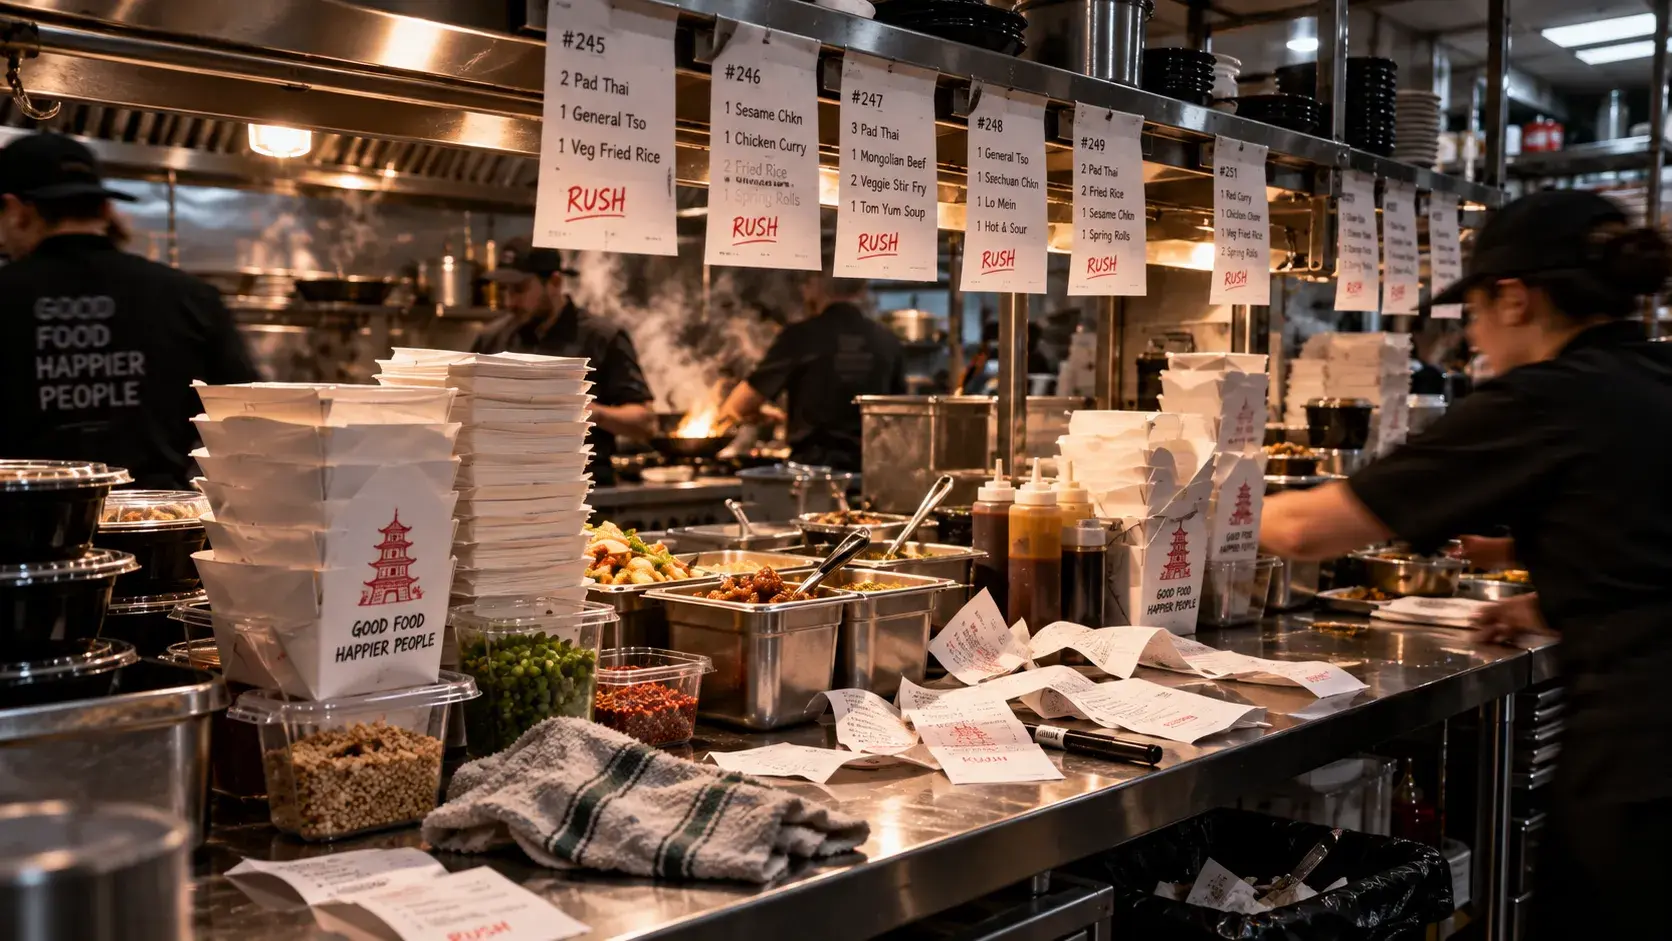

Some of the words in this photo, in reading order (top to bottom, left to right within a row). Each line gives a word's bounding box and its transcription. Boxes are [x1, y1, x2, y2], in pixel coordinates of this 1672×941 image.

[562, 30, 606, 54] #245
[560, 70, 569, 86] 2
[574, 72, 598, 92] Pad
[602, 78, 629, 96] Thai
[725, 64, 761, 85] #246
[852, 89, 883, 108] #247
[560, 104, 566, 119] 1
[572, 106, 621, 127] General
[626, 113, 647, 130] Tso
[725, 101, 730, 114] 1
[735, 103, 775, 121] Sesame
[777, 109, 803, 126] Chkn
[851, 122, 858, 135] 3
[861, 123, 878, 138] Pad
[880, 126, 900, 141] Thai
[977, 116, 1003, 133] #248
[559, 138, 565, 153] 1
[571, 139, 595, 161] Veg
[600, 144, 631, 162] Fried
[636, 147, 661, 164] Rice
[725, 131, 730, 143] 1
[735, 132, 776, 150] Chicken
[779, 138, 807, 157] Curry
[1081, 137, 1105, 151] #249
[852, 149, 856, 160] 1
[861, 151, 904, 169] Mongolian
[907, 156, 926, 170] Beef
[978, 147, 982, 158] 1
[985, 147, 1014, 162] General
[1016, 153, 1029, 165] Tso
[724, 159, 731, 172] 2
[735, 160, 763, 176] Fried
[765, 163, 787, 179] Rice
[1081, 163, 1087, 174] 2
[1089, 165, 1103, 177] Pad
[1104, 166, 1118, 178] Thai
[1220, 166, 1238, 179] #251
[851, 175, 857, 186] 2
[860, 175, 890, 193] Veggie
[893, 179, 909, 192] Stir
[912, 183, 927, 197] Fry
[978, 171, 981, 182] 1
[1021, 177, 1039, 190] Chkn
[567, 186, 626, 213] RUSH
[776, 191, 801, 207] Rolls
[1081, 186, 1087, 196] 2
[1089, 186, 1108, 198] Fried
[1109, 188, 1124, 199] Rice
[1226, 190, 1236, 200] Red
[851, 201, 856, 212] 1
[861, 201, 879, 215] Tom
[882, 204, 901, 216] Yum
[904, 206, 925, 221] Soup
[978, 196, 981, 207] 1
[985, 196, 995, 208] Lo
[998, 198, 1016, 210] Mein
[1082, 207, 1086, 217] 1
[1089, 208, 1116, 220] Sesame
[732, 216, 778, 238] RUSH
[977, 220, 981, 231] 1
[985, 221, 999, 232] Hot
[1010, 222, 1027, 235] Sour
[1082, 230, 1086, 239] 1
[1089, 230, 1113, 243] Spring
[1114, 230, 1130, 242] Rolls
[1227, 228, 1236, 241] Veg
[858, 232, 898, 252] RUSH
[1221, 247, 1225, 256] 2
[981, 249, 1016, 269] RUSH
[1087, 255, 1117, 274] RUSH
[1224, 270, 1247, 285] RUSH
[36, 324, 110, 350] FOOD
[36, 351, 146, 380] HAPPIER
[39, 381, 140, 411] PEOPLE
[1157, 587, 1174, 600] GOOD
[1177, 585, 1191, 596] FOOD
[352, 618, 388, 638] GOOD
[393, 613, 425, 632] FOOD
[335, 639, 389, 663] HAPPIER
[394, 632, 435, 654] PEOPLE
